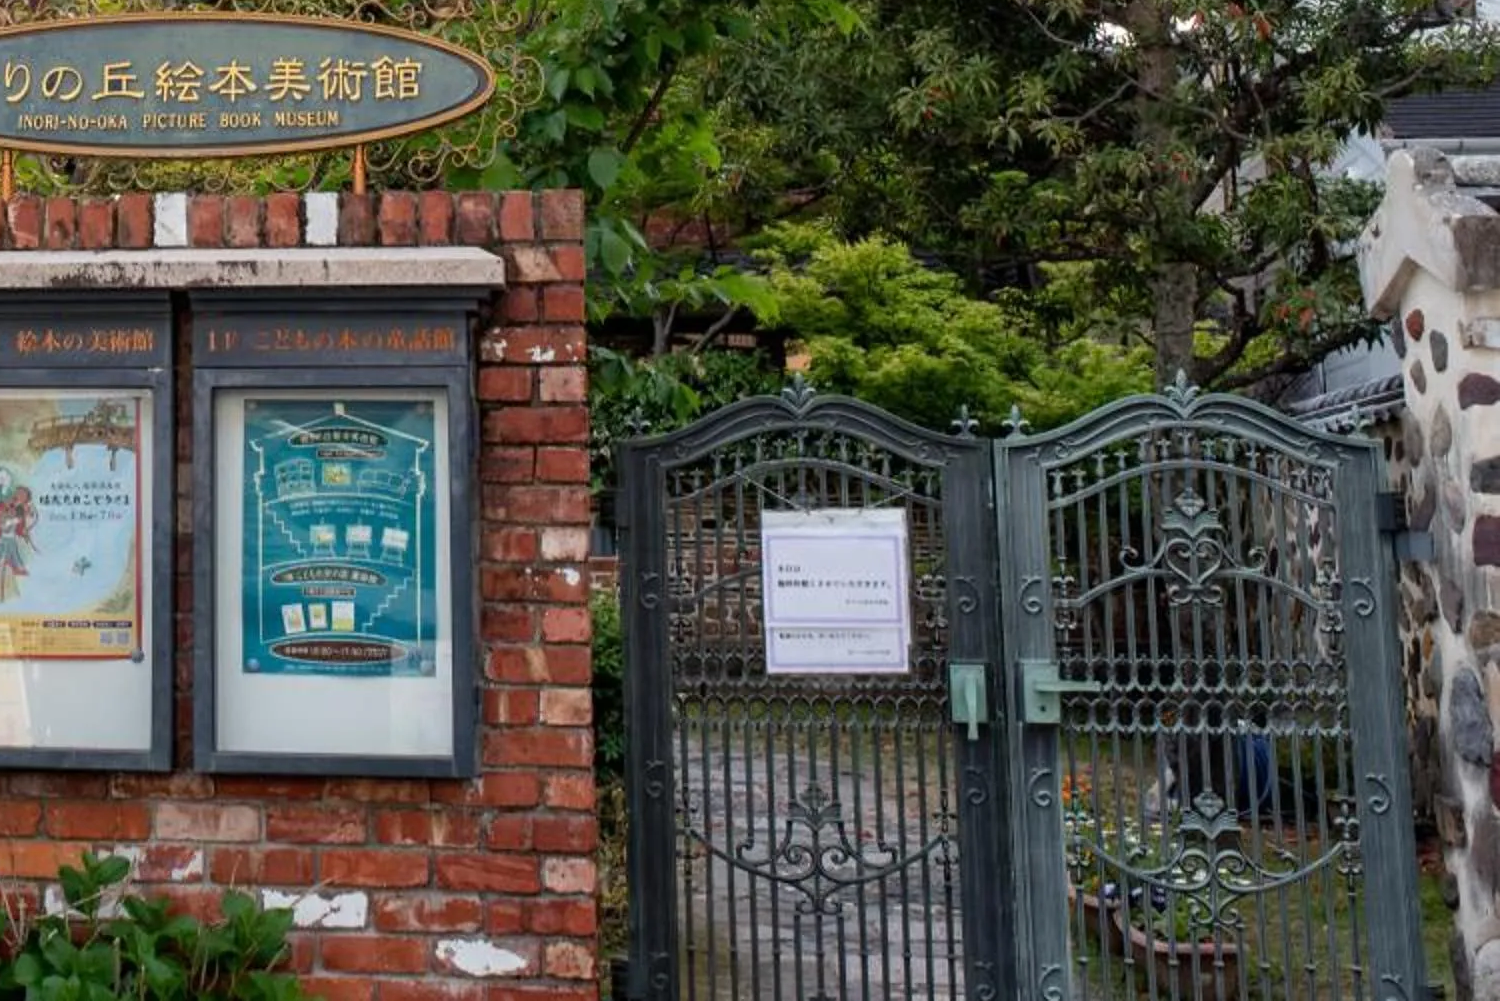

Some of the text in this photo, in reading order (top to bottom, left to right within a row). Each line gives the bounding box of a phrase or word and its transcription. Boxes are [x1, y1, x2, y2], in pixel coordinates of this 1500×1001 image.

[18, 110, 341, 131] INORI-NO-OKA PICTURE BOOK MUSEUM
[16, 328, 155, 353] 絵本の美術館
